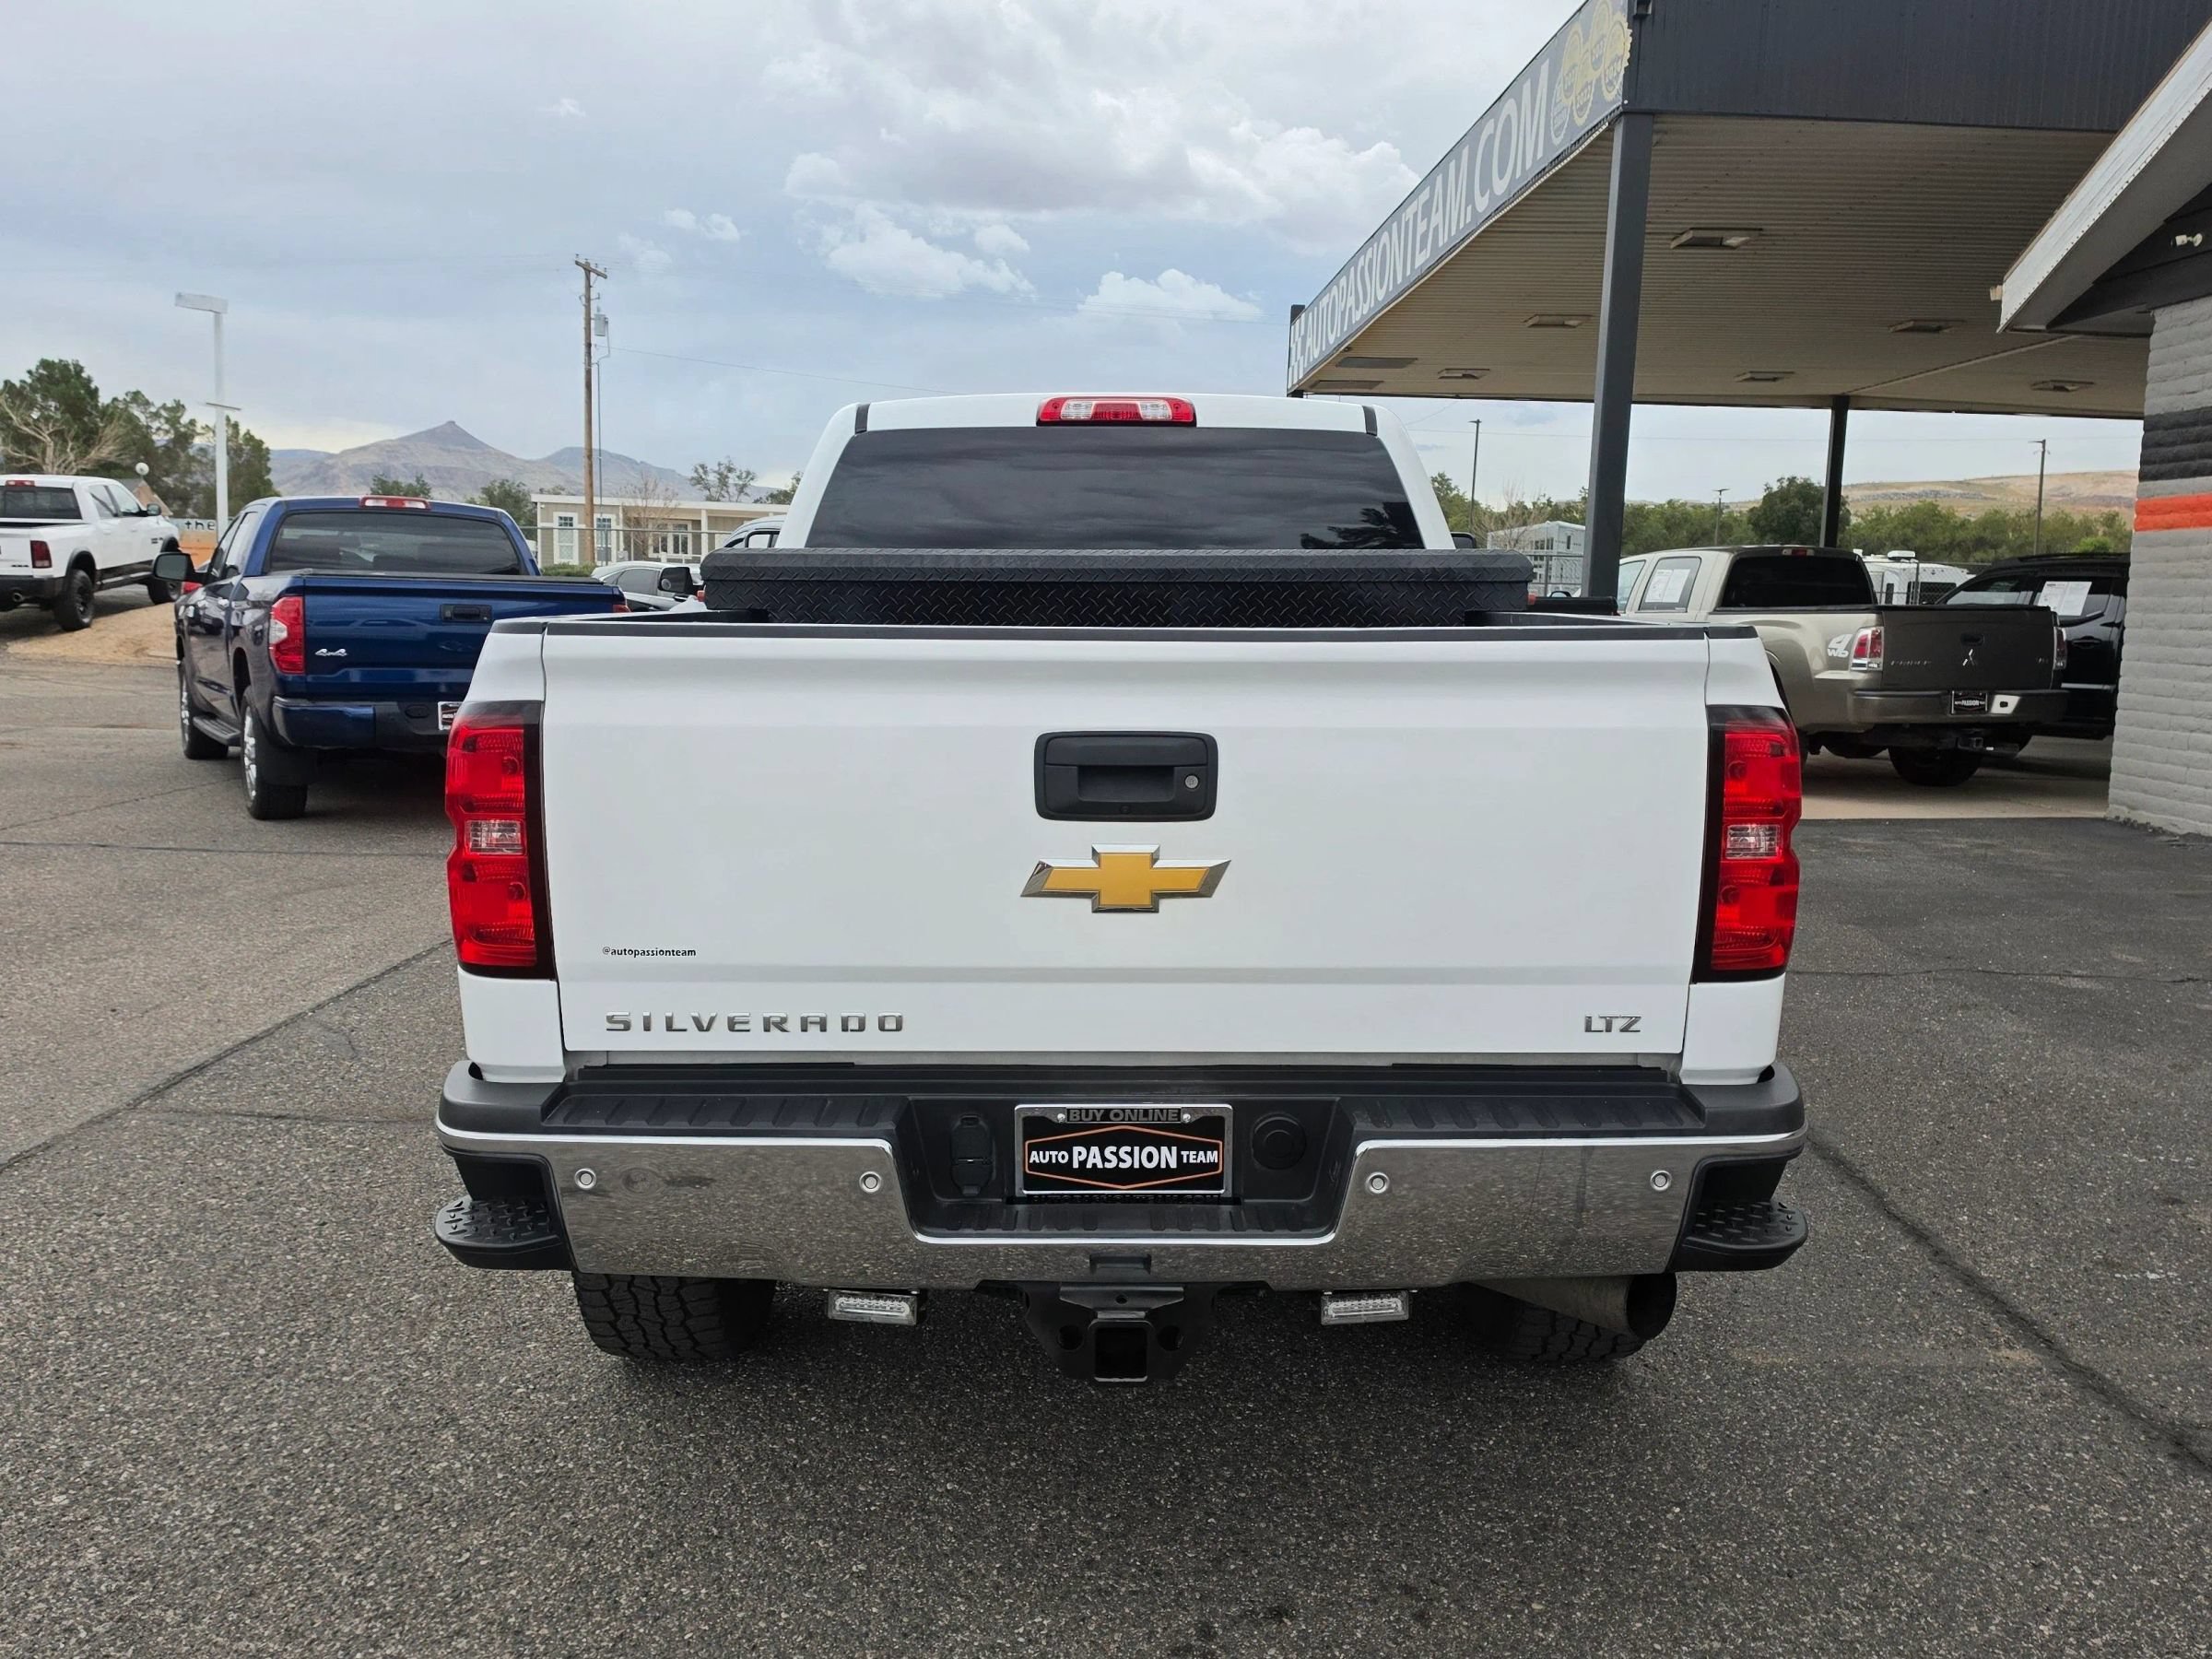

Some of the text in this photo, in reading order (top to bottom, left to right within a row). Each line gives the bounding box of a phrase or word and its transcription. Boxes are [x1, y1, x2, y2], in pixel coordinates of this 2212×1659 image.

[1304, 58, 1550, 368] AUTOPASSIONTEAM.COM
[185, 520, 216, 530] the
[602, 946, 697, 958] @autopassionteam
[606, 1011, 904, 1032] SILVERADO
[1584, 1014, 1641, 1032] LTZ
[1069, 1109, 1179, 1122] BUY ONLINE
[1029, 1146, 1218, 1169] AUTO PASSION TEAM
